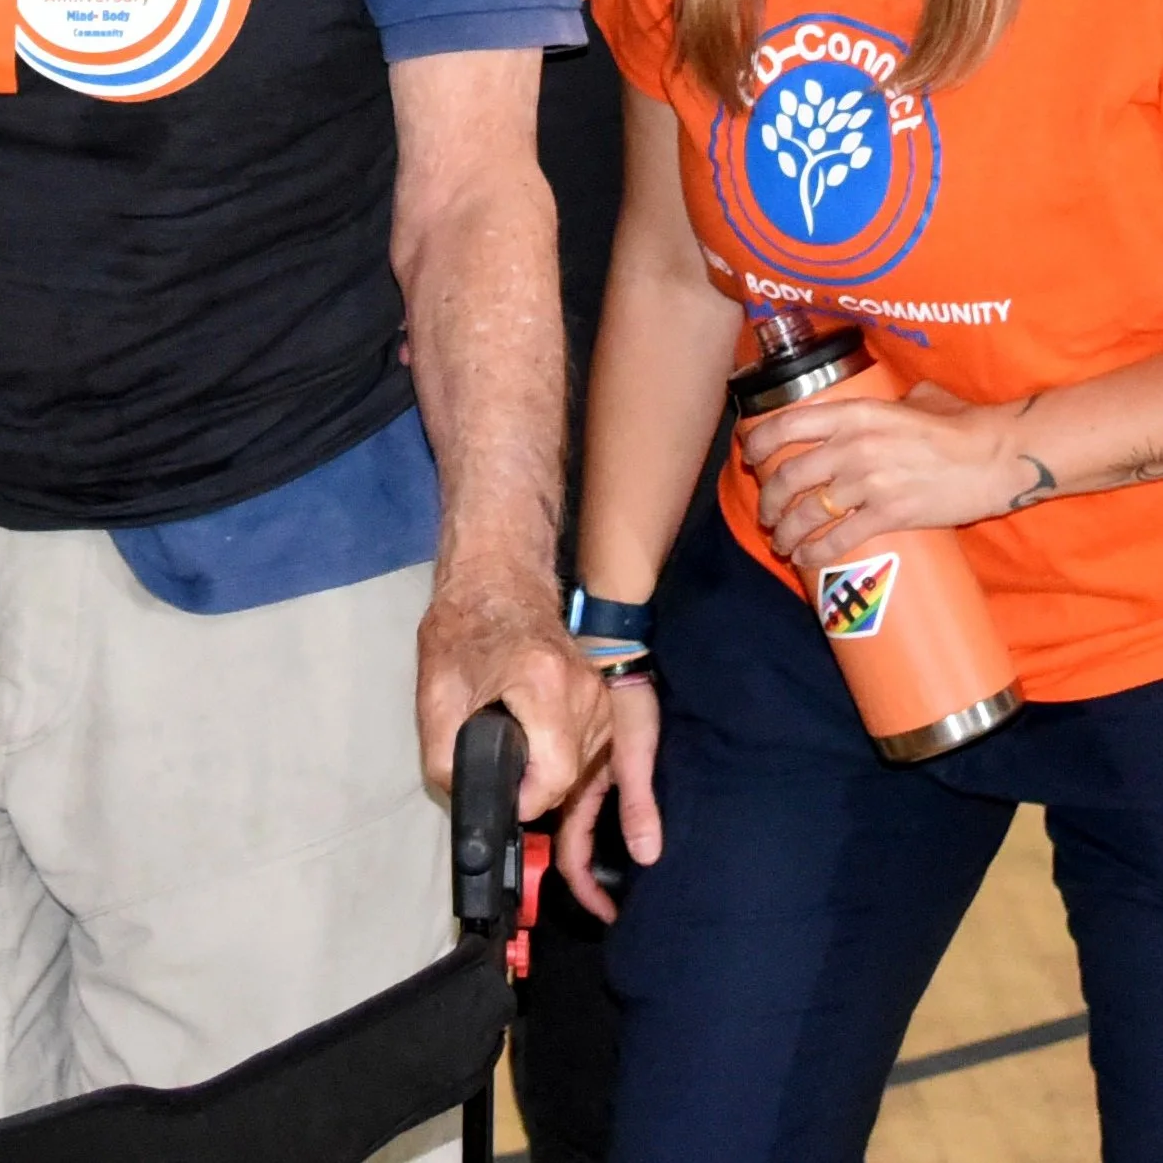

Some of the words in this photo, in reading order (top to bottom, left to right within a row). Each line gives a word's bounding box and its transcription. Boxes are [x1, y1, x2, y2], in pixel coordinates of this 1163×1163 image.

[102, 9, 130, 22] Body
[73, 27, 124, 38] Community
[738, 24, 923, 135] D-Connct
[744, 272, 814, 304] BODY
[838, 298, 1012, 325] COMMUNITY
